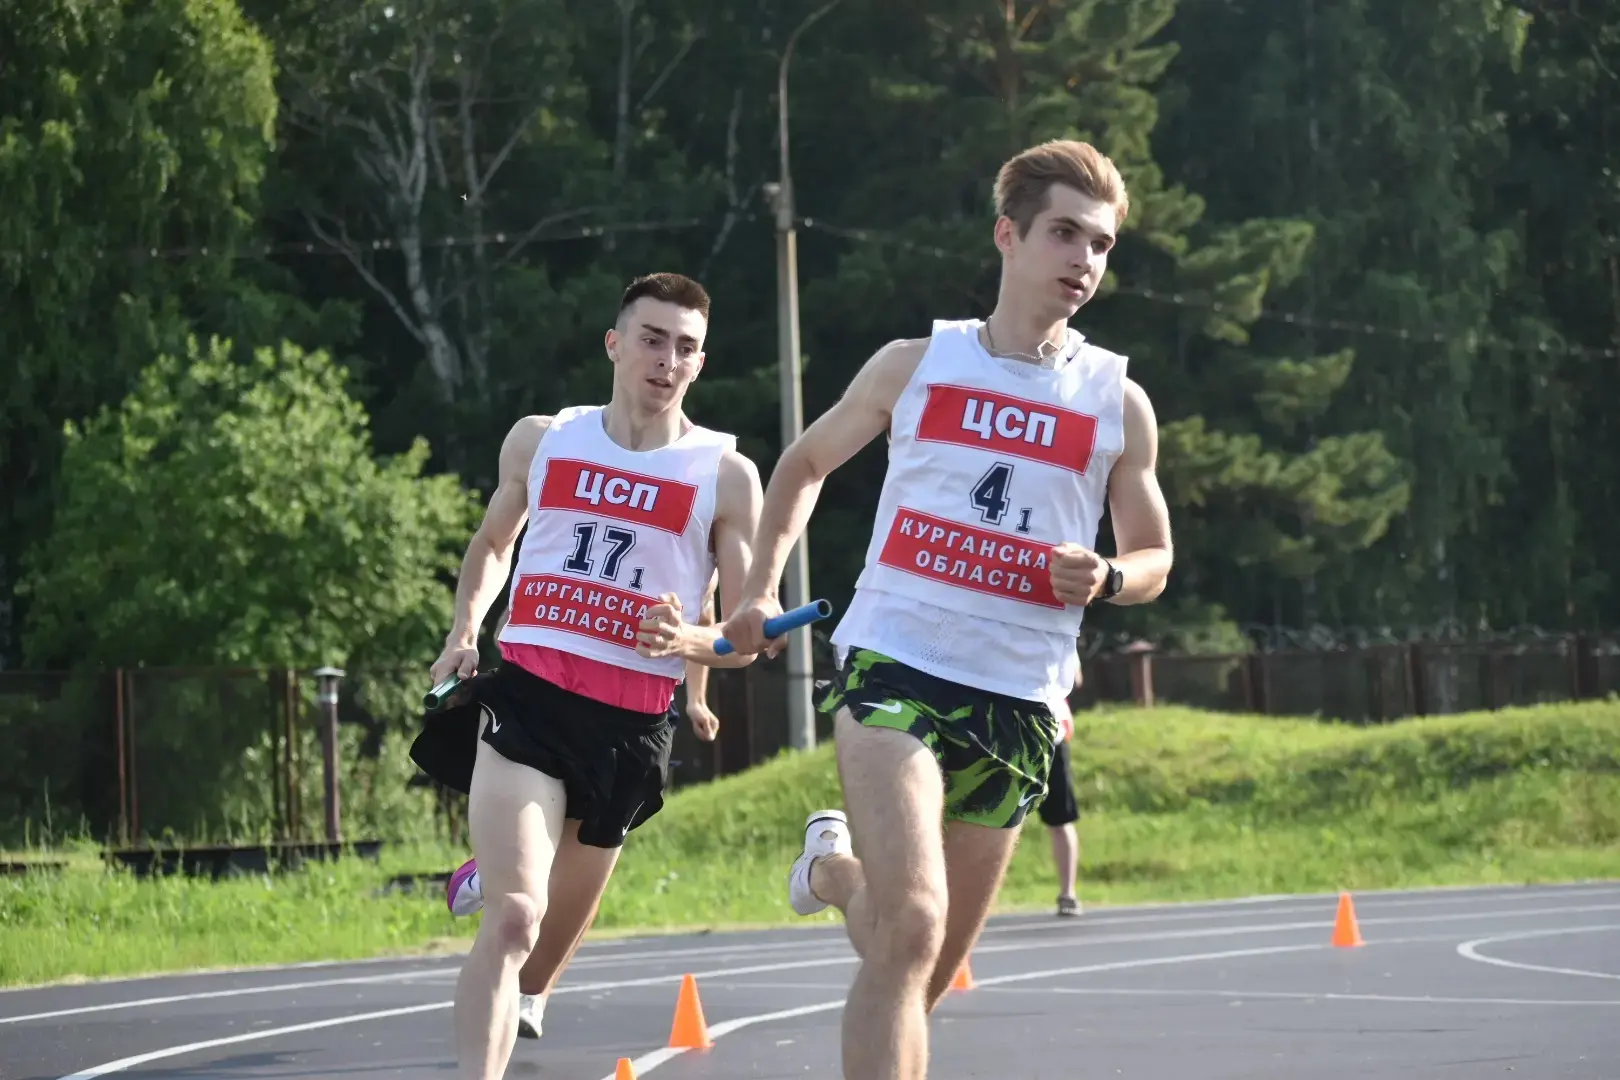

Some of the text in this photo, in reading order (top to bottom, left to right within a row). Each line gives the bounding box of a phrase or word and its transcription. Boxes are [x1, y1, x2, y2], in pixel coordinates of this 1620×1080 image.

[961, 398, 1057, 448] ЦСП
[574, 469, 660, 512] ЦСП
[969, 462, 1032, 534] 4 1
[563, 522, 644, 591] 17 1
[900, 517, 1046, 570] КУРГАНСКА
[915, 550, 1032, 593] ОБЛАСТЬ
[524, 582, 658, 621] КУРГАНСКА
[535, 604, 636, 640] ОБЛАСТЬ
